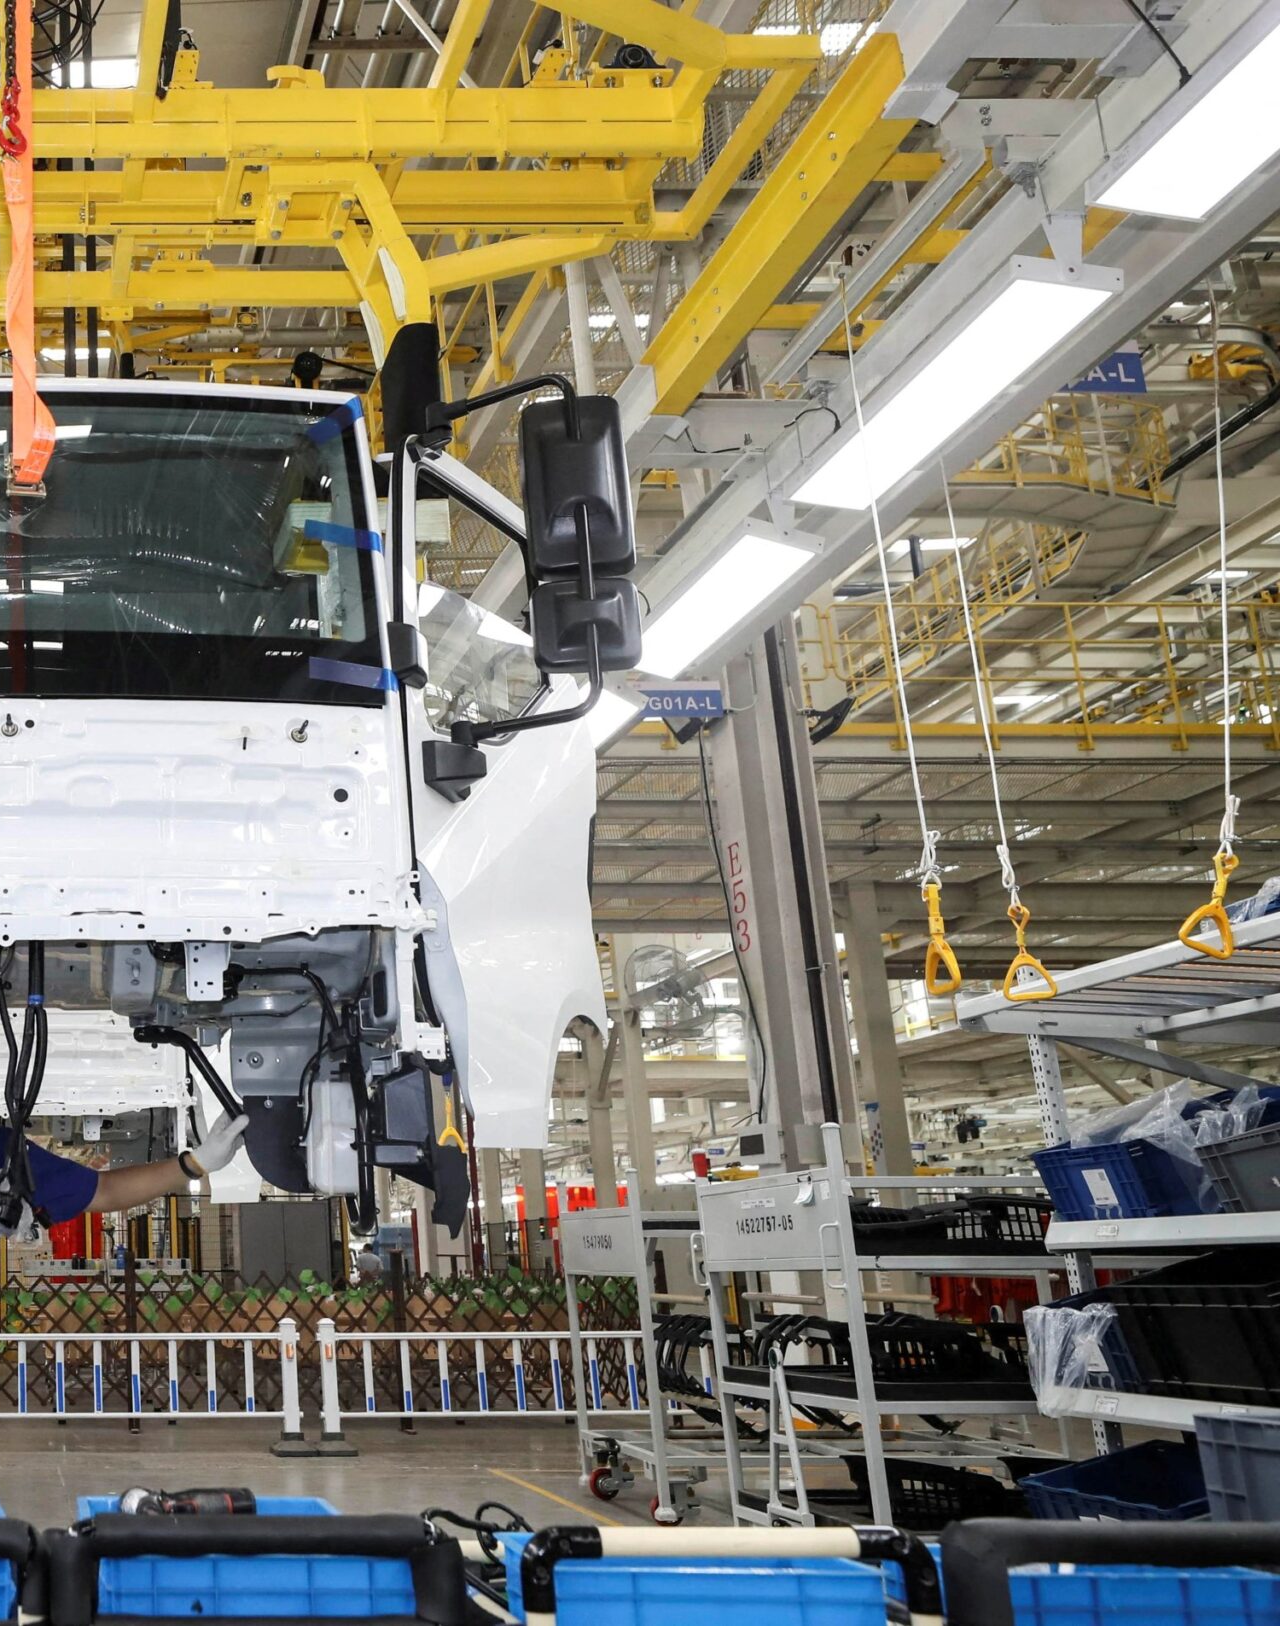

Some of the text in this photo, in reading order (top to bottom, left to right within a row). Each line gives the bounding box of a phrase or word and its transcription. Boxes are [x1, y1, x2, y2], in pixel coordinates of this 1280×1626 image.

[1080, 363, 1136, 383] A-L
[648, 697, 717, 711] G01A-L
[736, 1215, 794, 1235] 14522757-05
